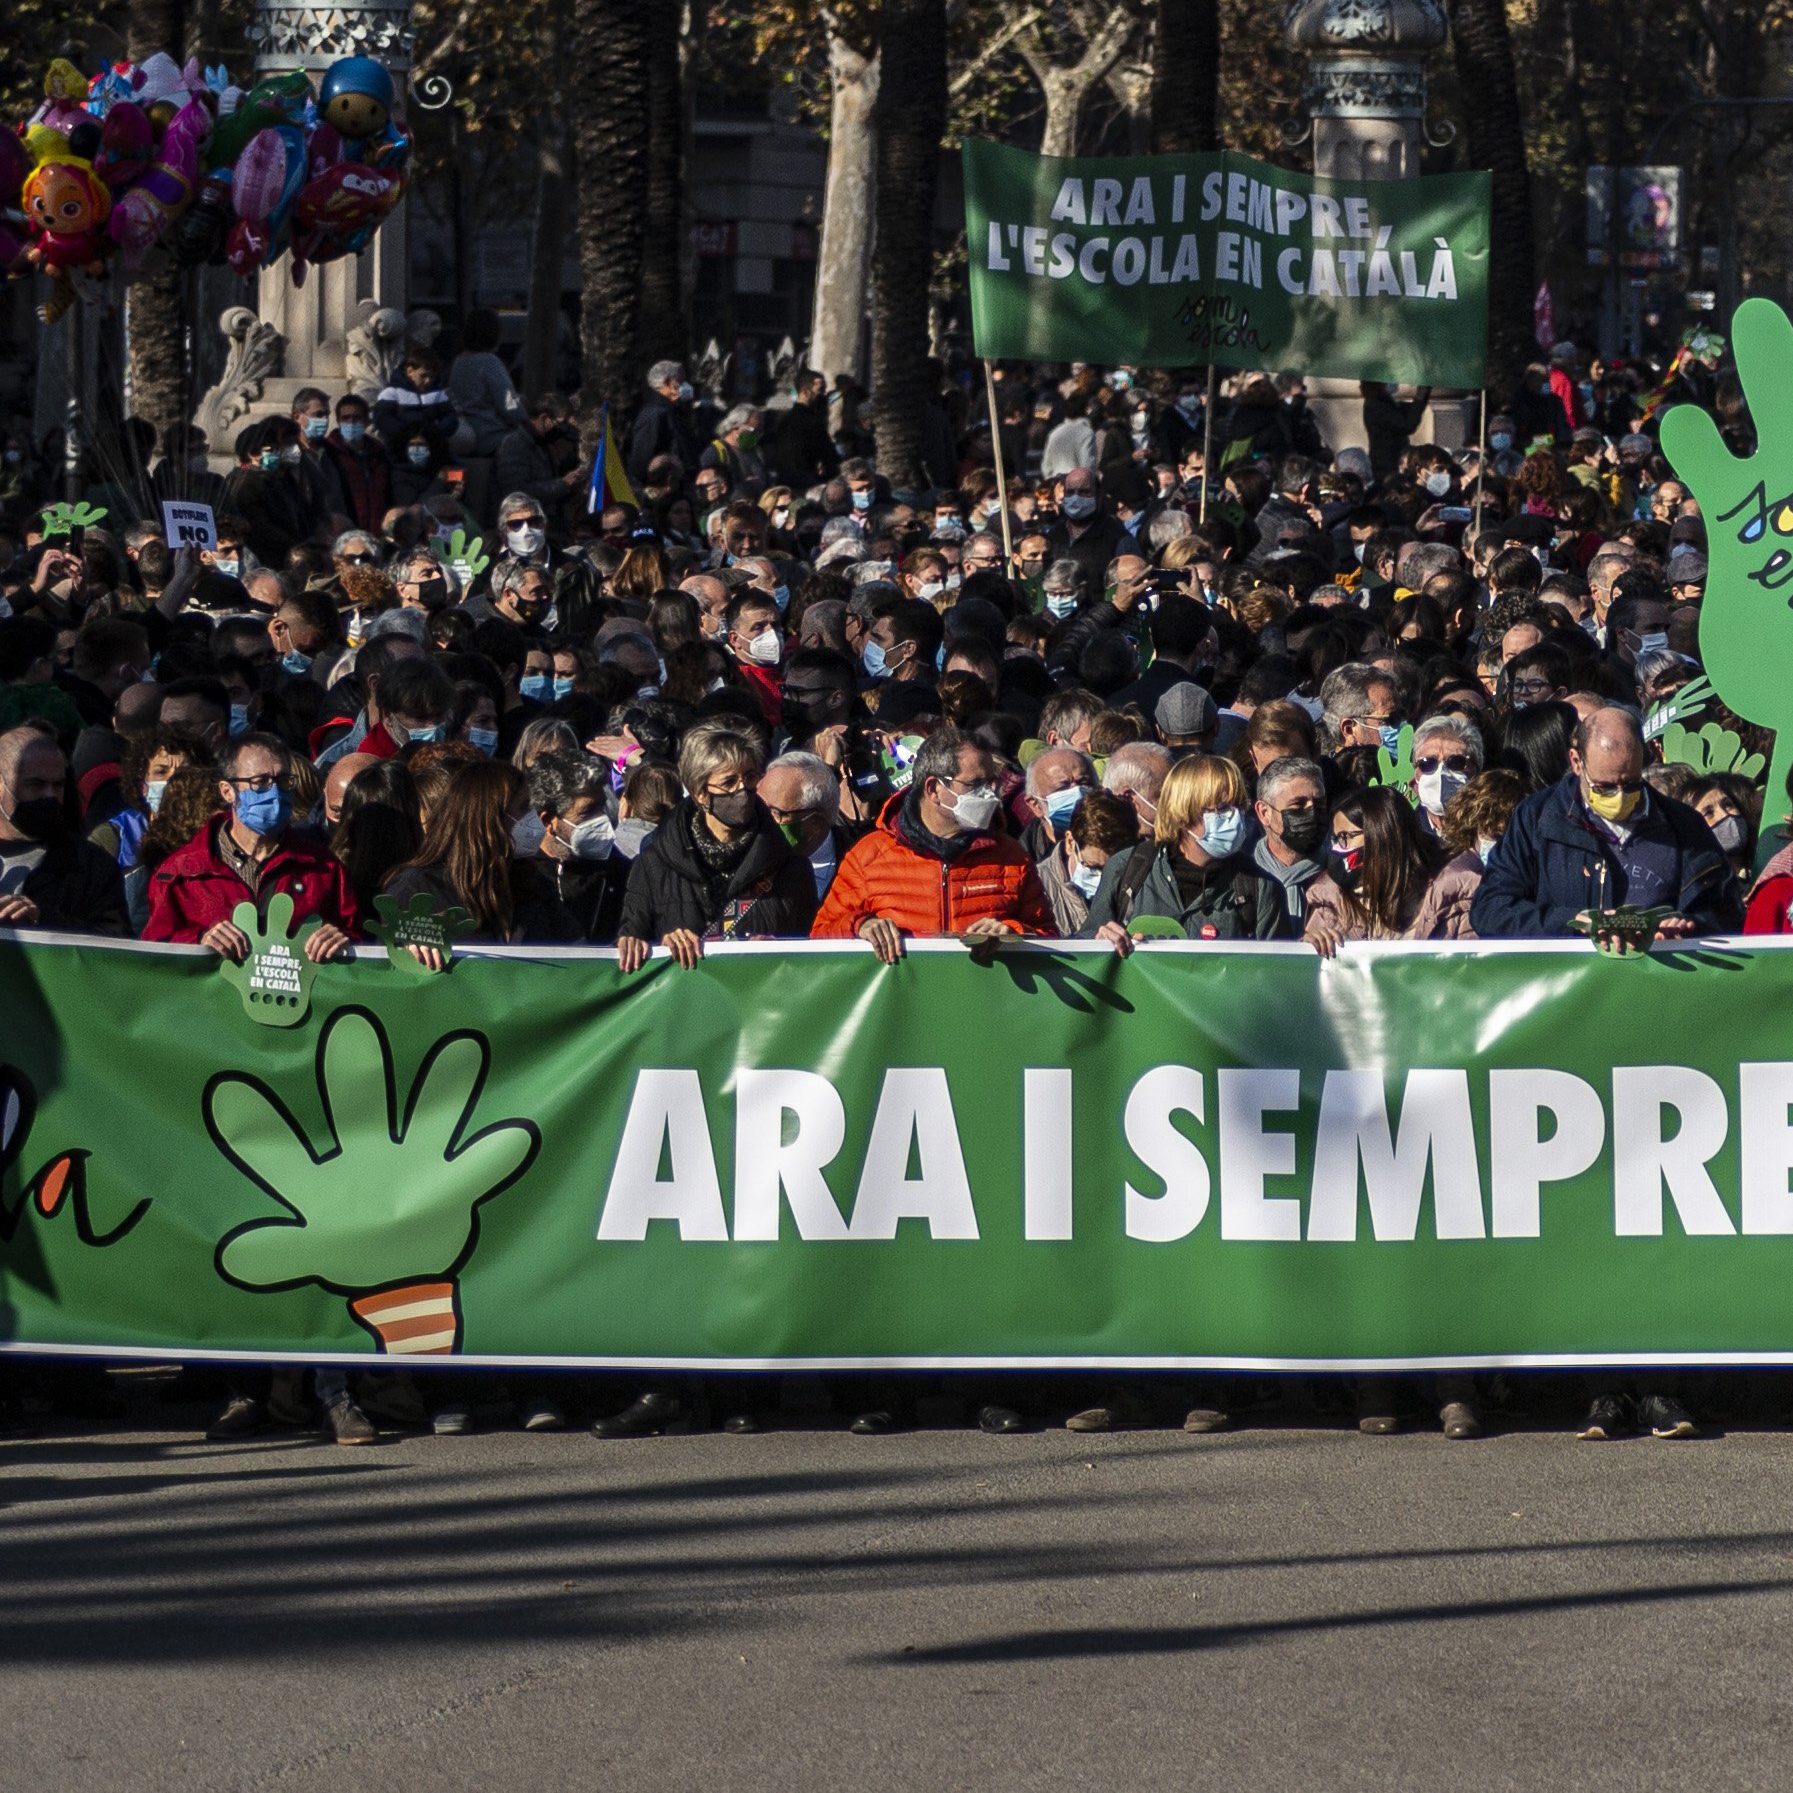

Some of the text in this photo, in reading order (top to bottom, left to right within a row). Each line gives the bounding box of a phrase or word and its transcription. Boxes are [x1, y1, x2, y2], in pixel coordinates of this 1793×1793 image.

[1050, 177, 1155, 225] ARA
[1172, 174, 1186, 223] I
[987, 221, 1200, 286] L'ESCOLA
[1216, 231, 1262, 289] EN
[178, 525, 210, 543] NO
[269, 944, 291, 956] ARA
[254, 953, 259, 965] I
[255, 964, 300, 981] L'ESCOLA
[250, 975, 264, 988] EN
[597, 1068, 981, 1241] ARA
[1023, 1068, 1074, 1241] I
